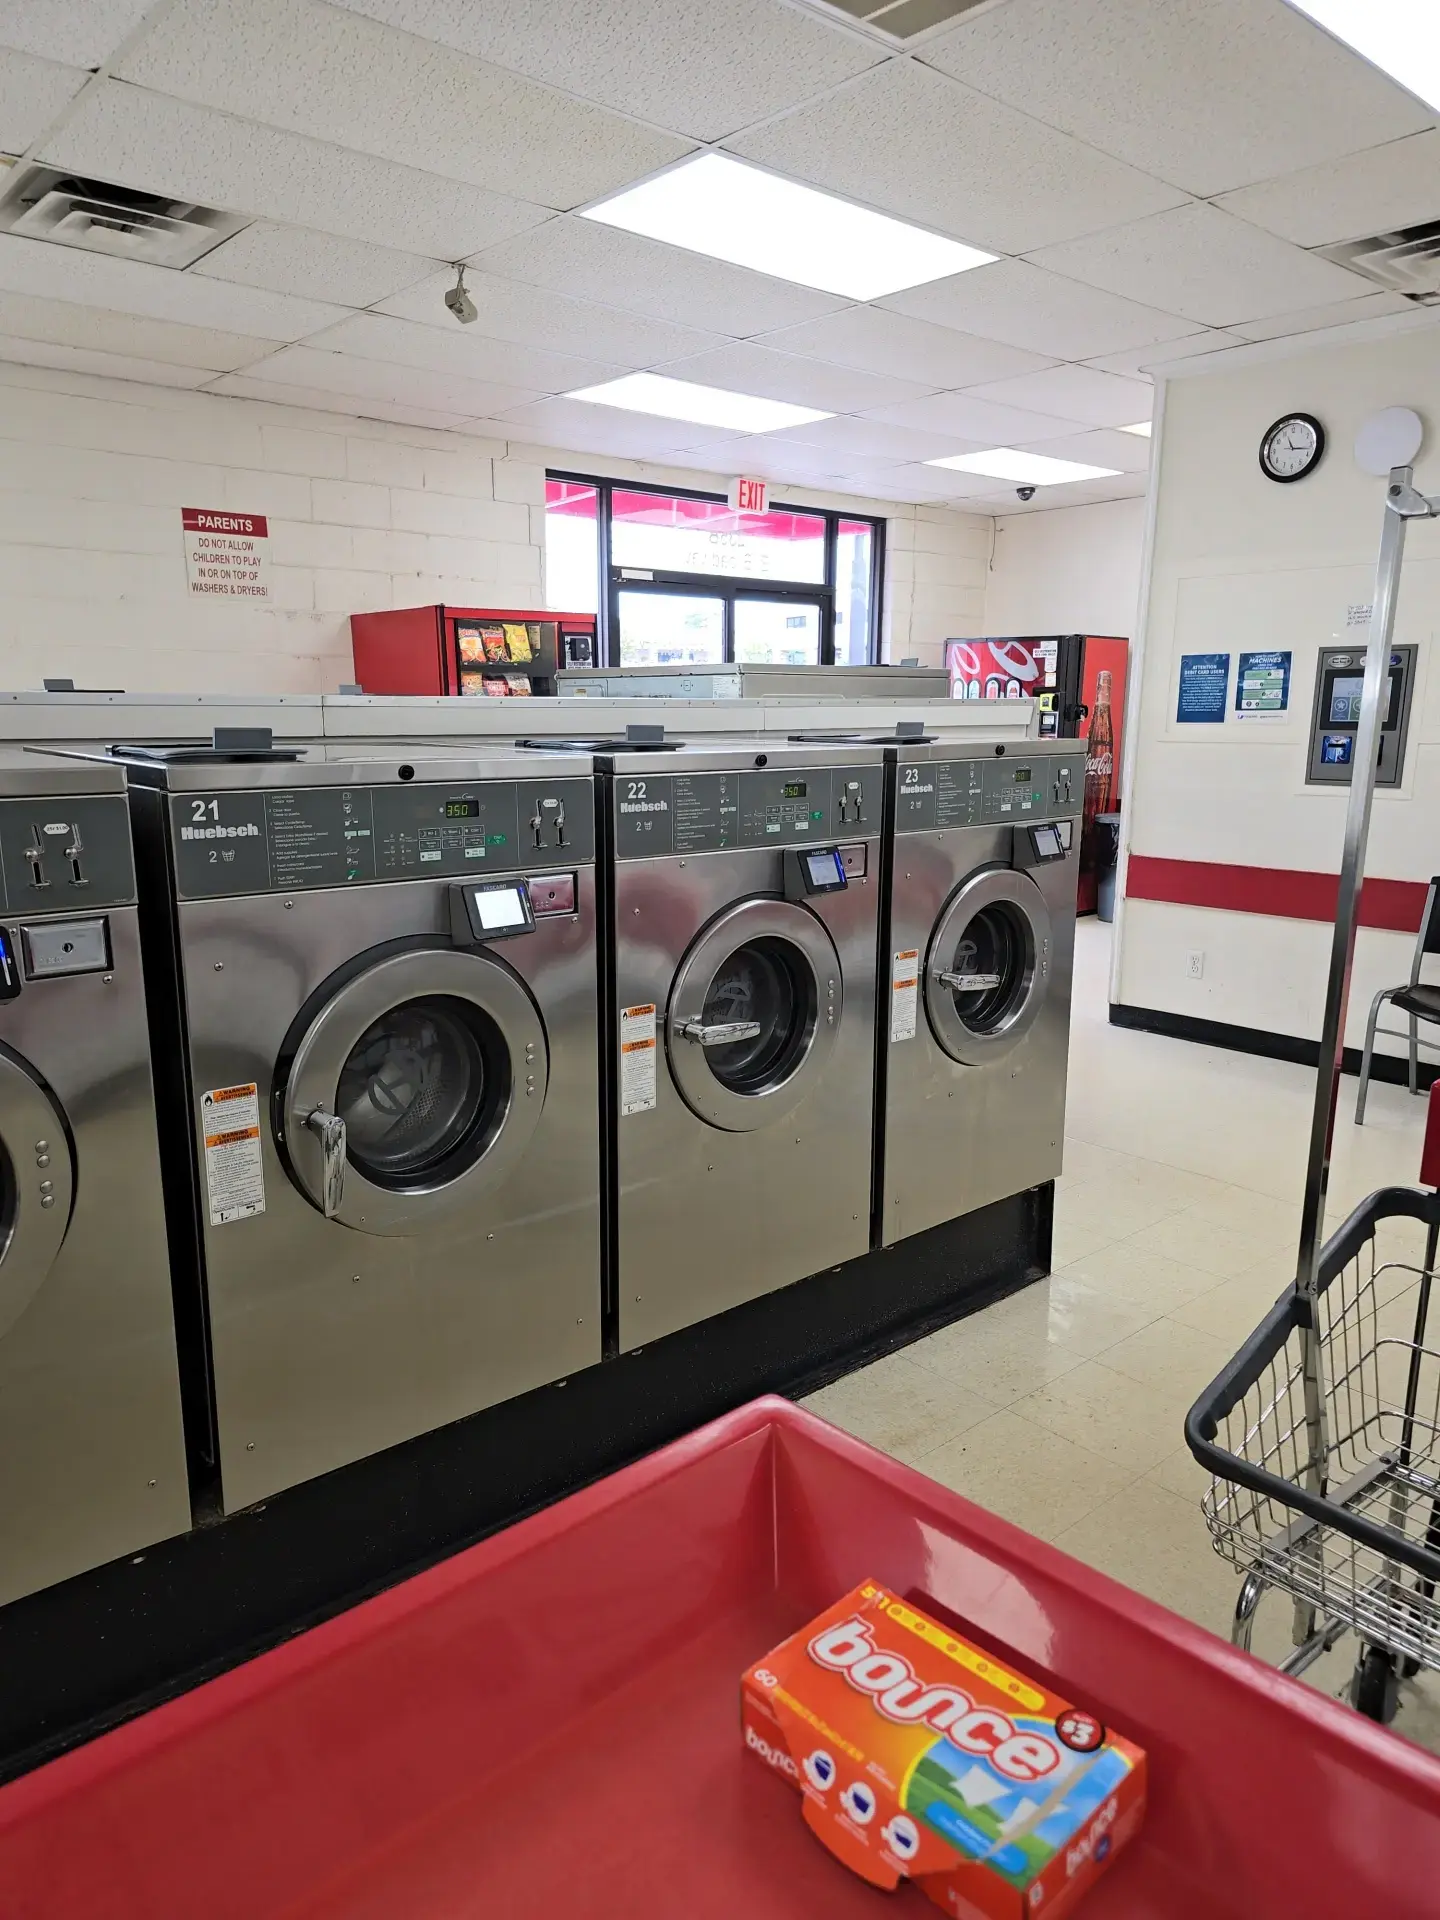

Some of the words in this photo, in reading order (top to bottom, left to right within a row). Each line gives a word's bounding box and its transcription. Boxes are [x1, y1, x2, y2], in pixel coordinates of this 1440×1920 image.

[738, 480, 765, 511] EXIT
[198, 515, 253, 532] PARENTS
[198, 538, 210, 548] DO
[212, 539, 226, 548] NOT
[228, 540, 254, 552] ALLOW
[192, 552, 230, 564] CHILDREN
[232, 555, 241, 565] TO
[244, 556, 261, 566] PLAY
[198, 568, 206, 577] IN
[208, 568, 218, 578] OR
[220, 569, 231, 579] ON
[232, 570, 247, 580] TOP
[249, 572, 258, 580] OF
[192, 582, 228, 594] WASHERS
[230, 584, 235, 594] &
[237, 585, 268, 596] DRYERS!
[906, 769, 918, 783] 23
[628, 782, 646, 798] 22
[900, 784, 933, 794] Huebsch
[191, 800, 220, 821] 21
[447, 805, 468, 816] 350
[620, 800, 668, 813] Huebsch
[910, 801, 914, 809] 2
[181, 823, 259, 840] Huebsch
[636, 822, 641, 831] 2
[209, 850, 217, 862] 2
[222, 1086, 250, 1095] WARNING
[220, 1129, 248, 1139] WARNING
[754, 1668, 778, 1688] 60
[807, 1613, 1061, 1783] bounce
[1060, 1719, 1095, 1746] $3
